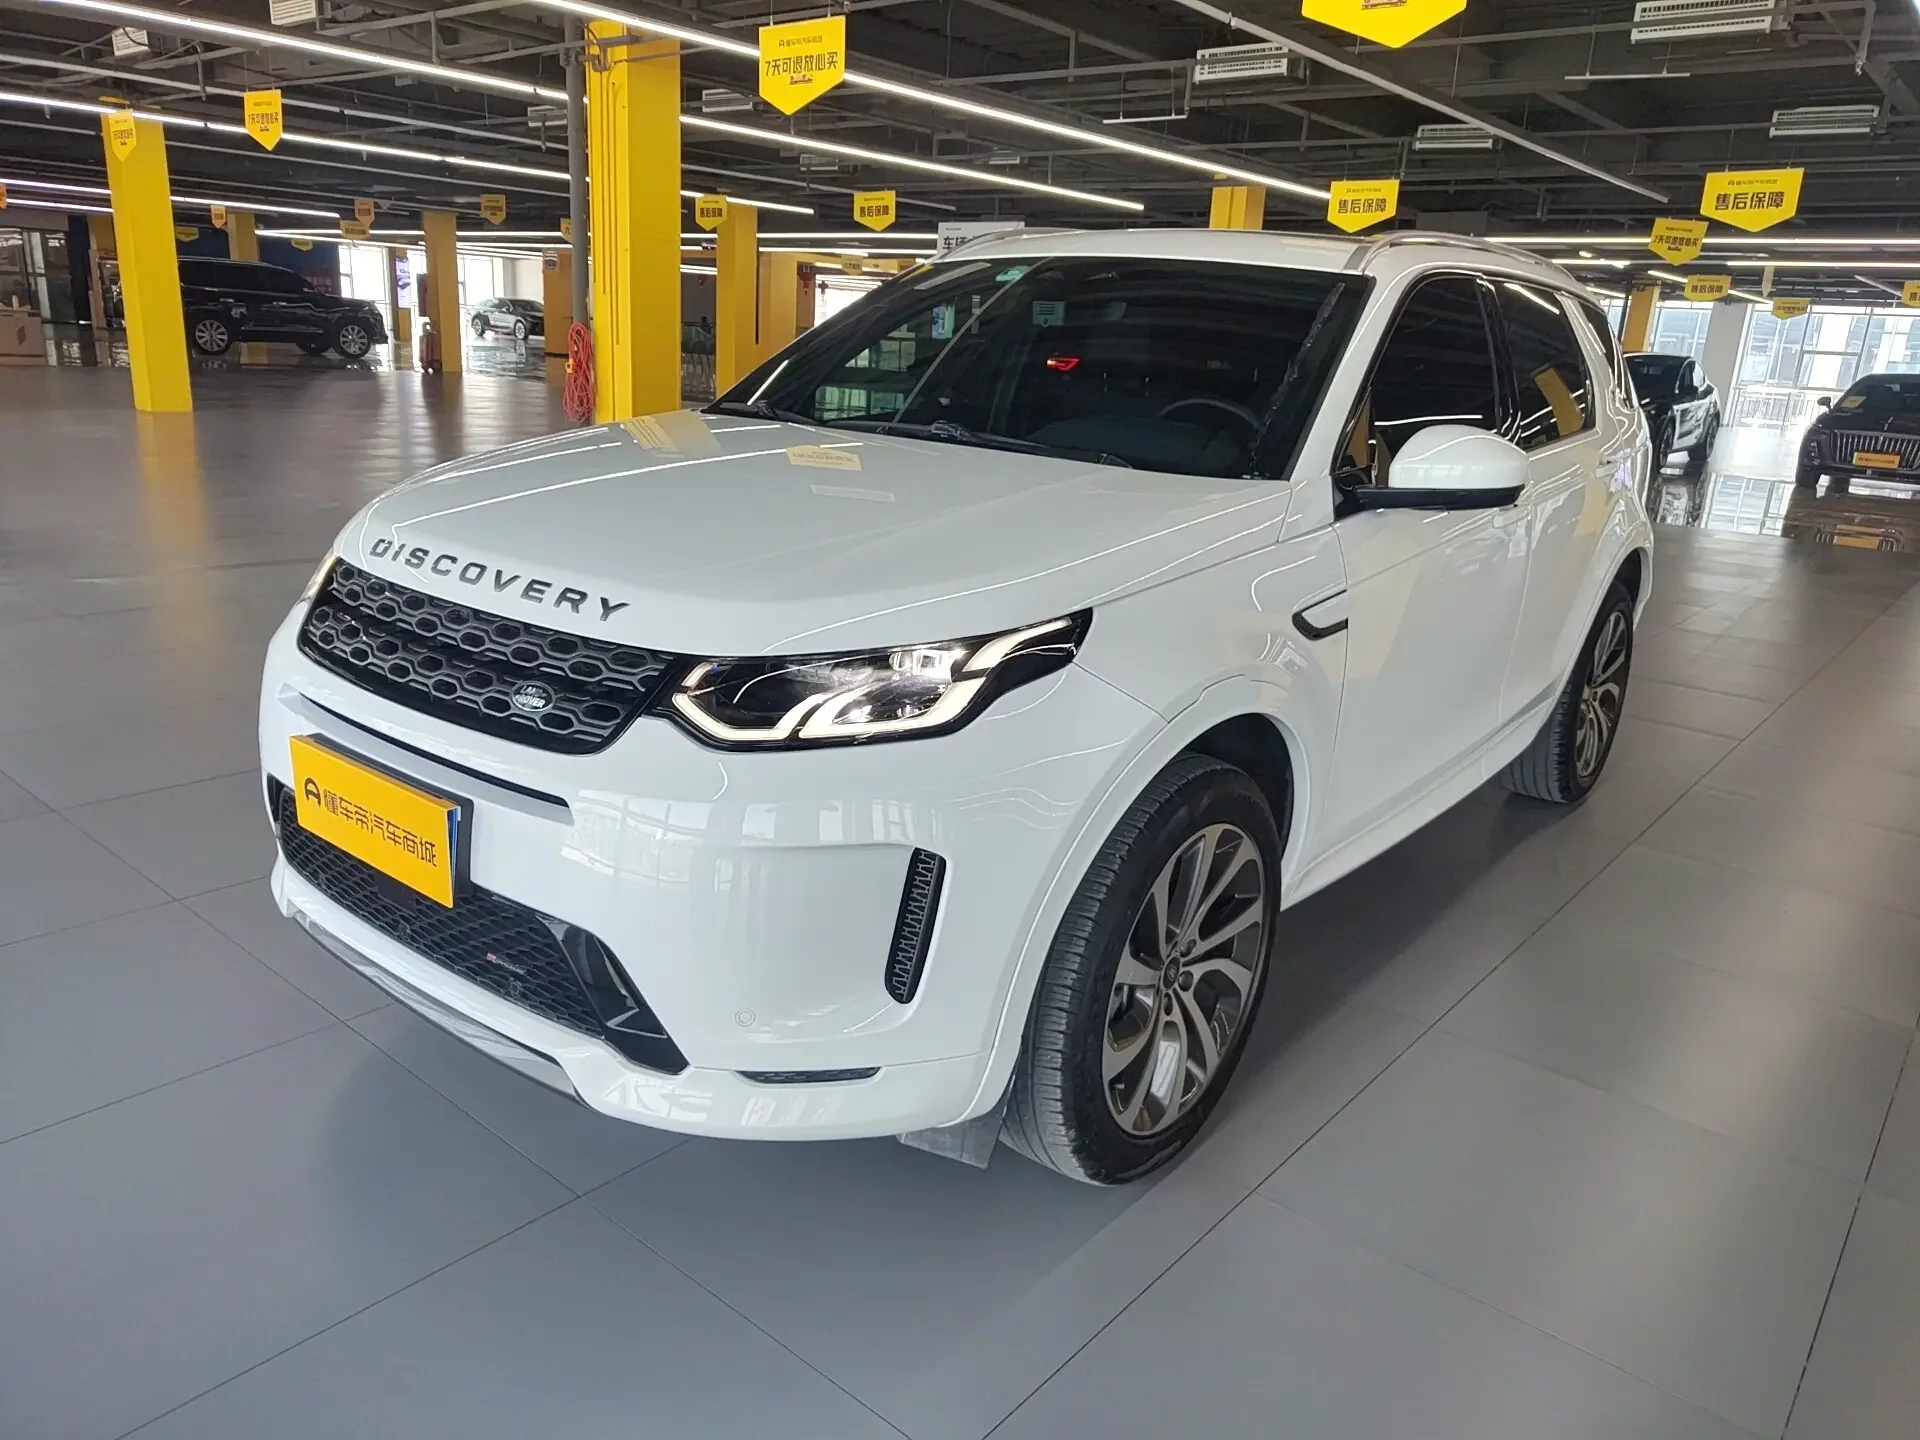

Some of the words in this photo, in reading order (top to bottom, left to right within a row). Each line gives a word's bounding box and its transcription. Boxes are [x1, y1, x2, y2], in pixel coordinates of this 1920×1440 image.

[764, 52, 836, 76] 7天可退放心买
[1338, 198, 1387, 214] 售后保障
[1714, 191, 1785, 210] 售后保障
[860, 205, 889, 217] 售后保障
[943, 236, 976, 249] 车辆
[370, 538, 630, 621] DISCOVERY
[519, 685, 544, 697] LAND
[517, 694, 546, 709] ROVER
[323, 789, 437, 867] 懂车帝汽车商城
